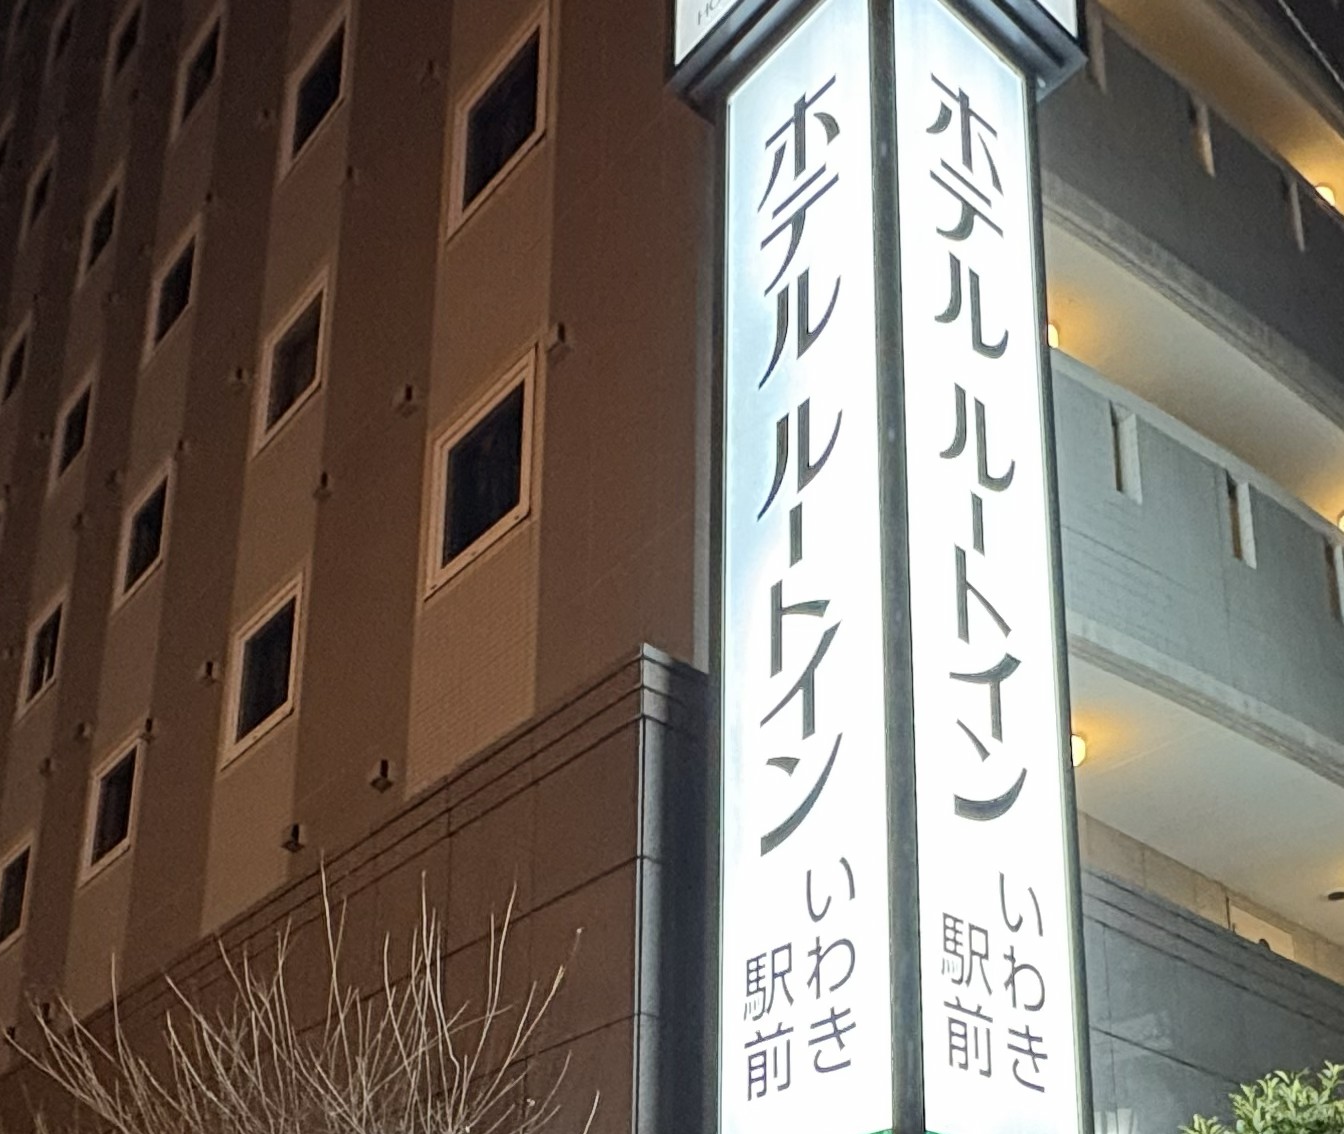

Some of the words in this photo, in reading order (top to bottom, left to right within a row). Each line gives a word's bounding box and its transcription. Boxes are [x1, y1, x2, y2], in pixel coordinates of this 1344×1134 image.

[743, 942, 795, 1102] 駅前
[805, 857, 857, 1074] いわき
[941, 911, 994, 1079] 駅前
[999, 871, 1049, 1094] いわき
